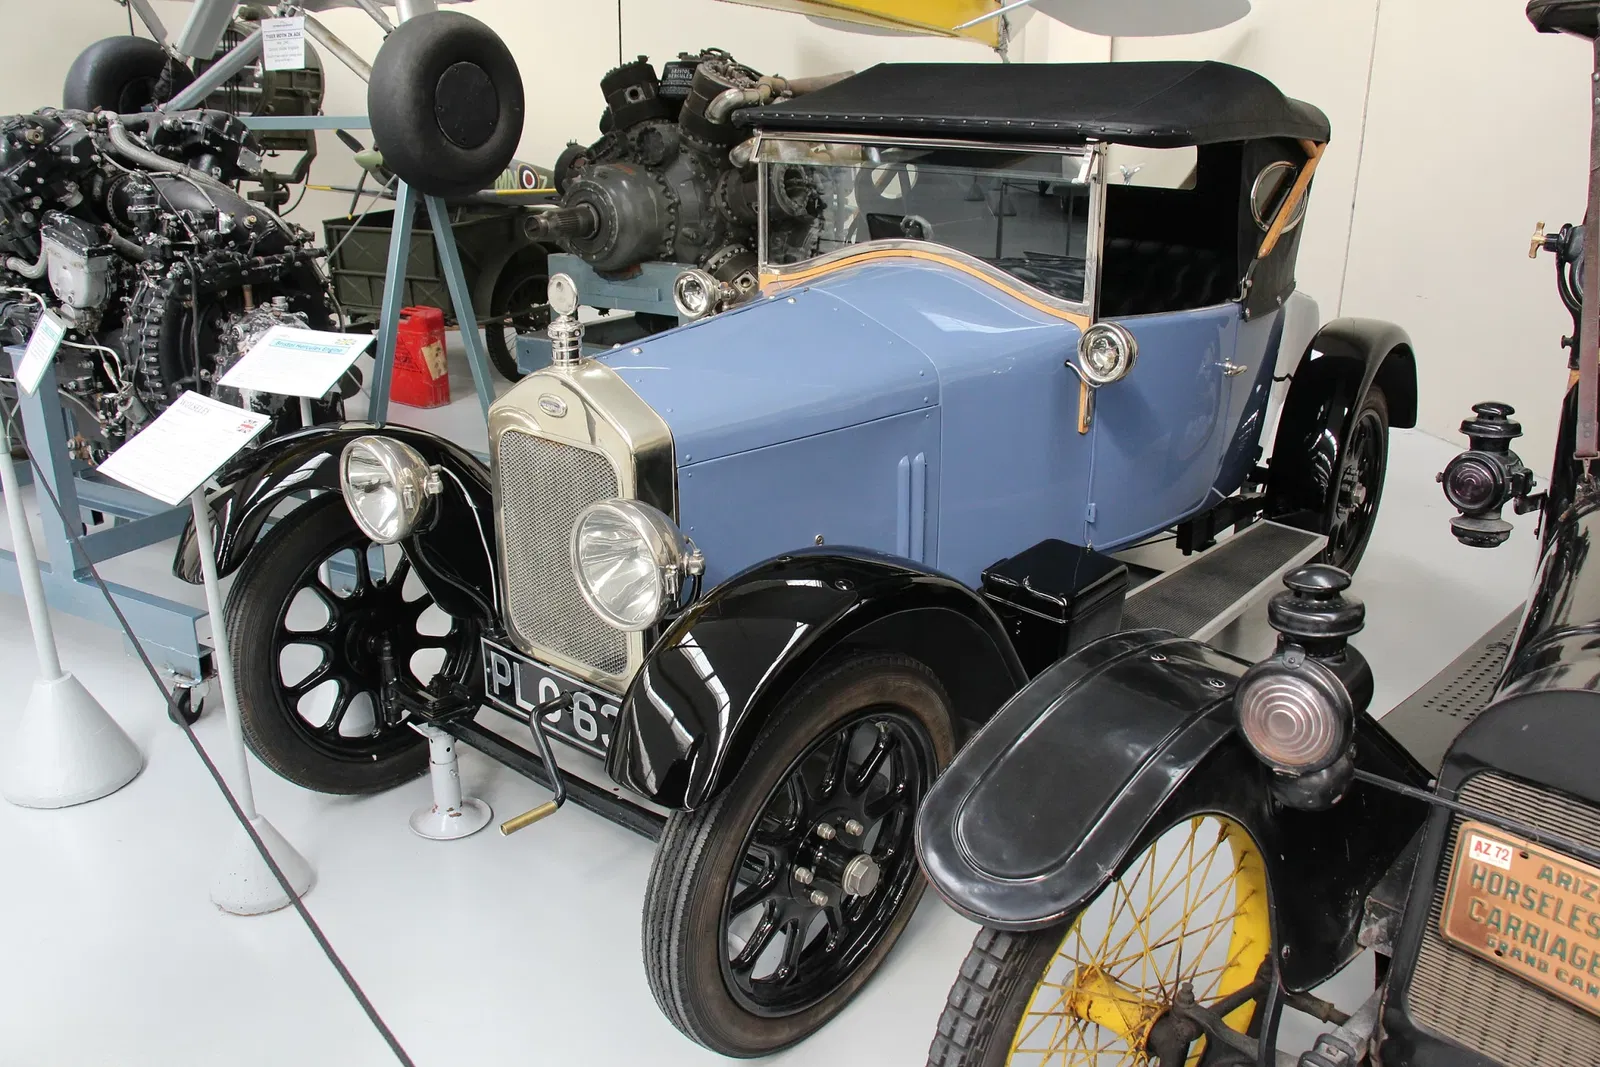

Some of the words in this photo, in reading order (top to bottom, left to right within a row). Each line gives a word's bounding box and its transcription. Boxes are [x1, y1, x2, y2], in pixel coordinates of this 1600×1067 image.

[179, 398, 211, 416] WOLSELEY
[1474, 840, 1491, 856] AZ
[1495, 845, 1510, 861] 72
[1537, 863, 1600, 904] ARIZ
[1486, 933, 1550, 974] GRAND
